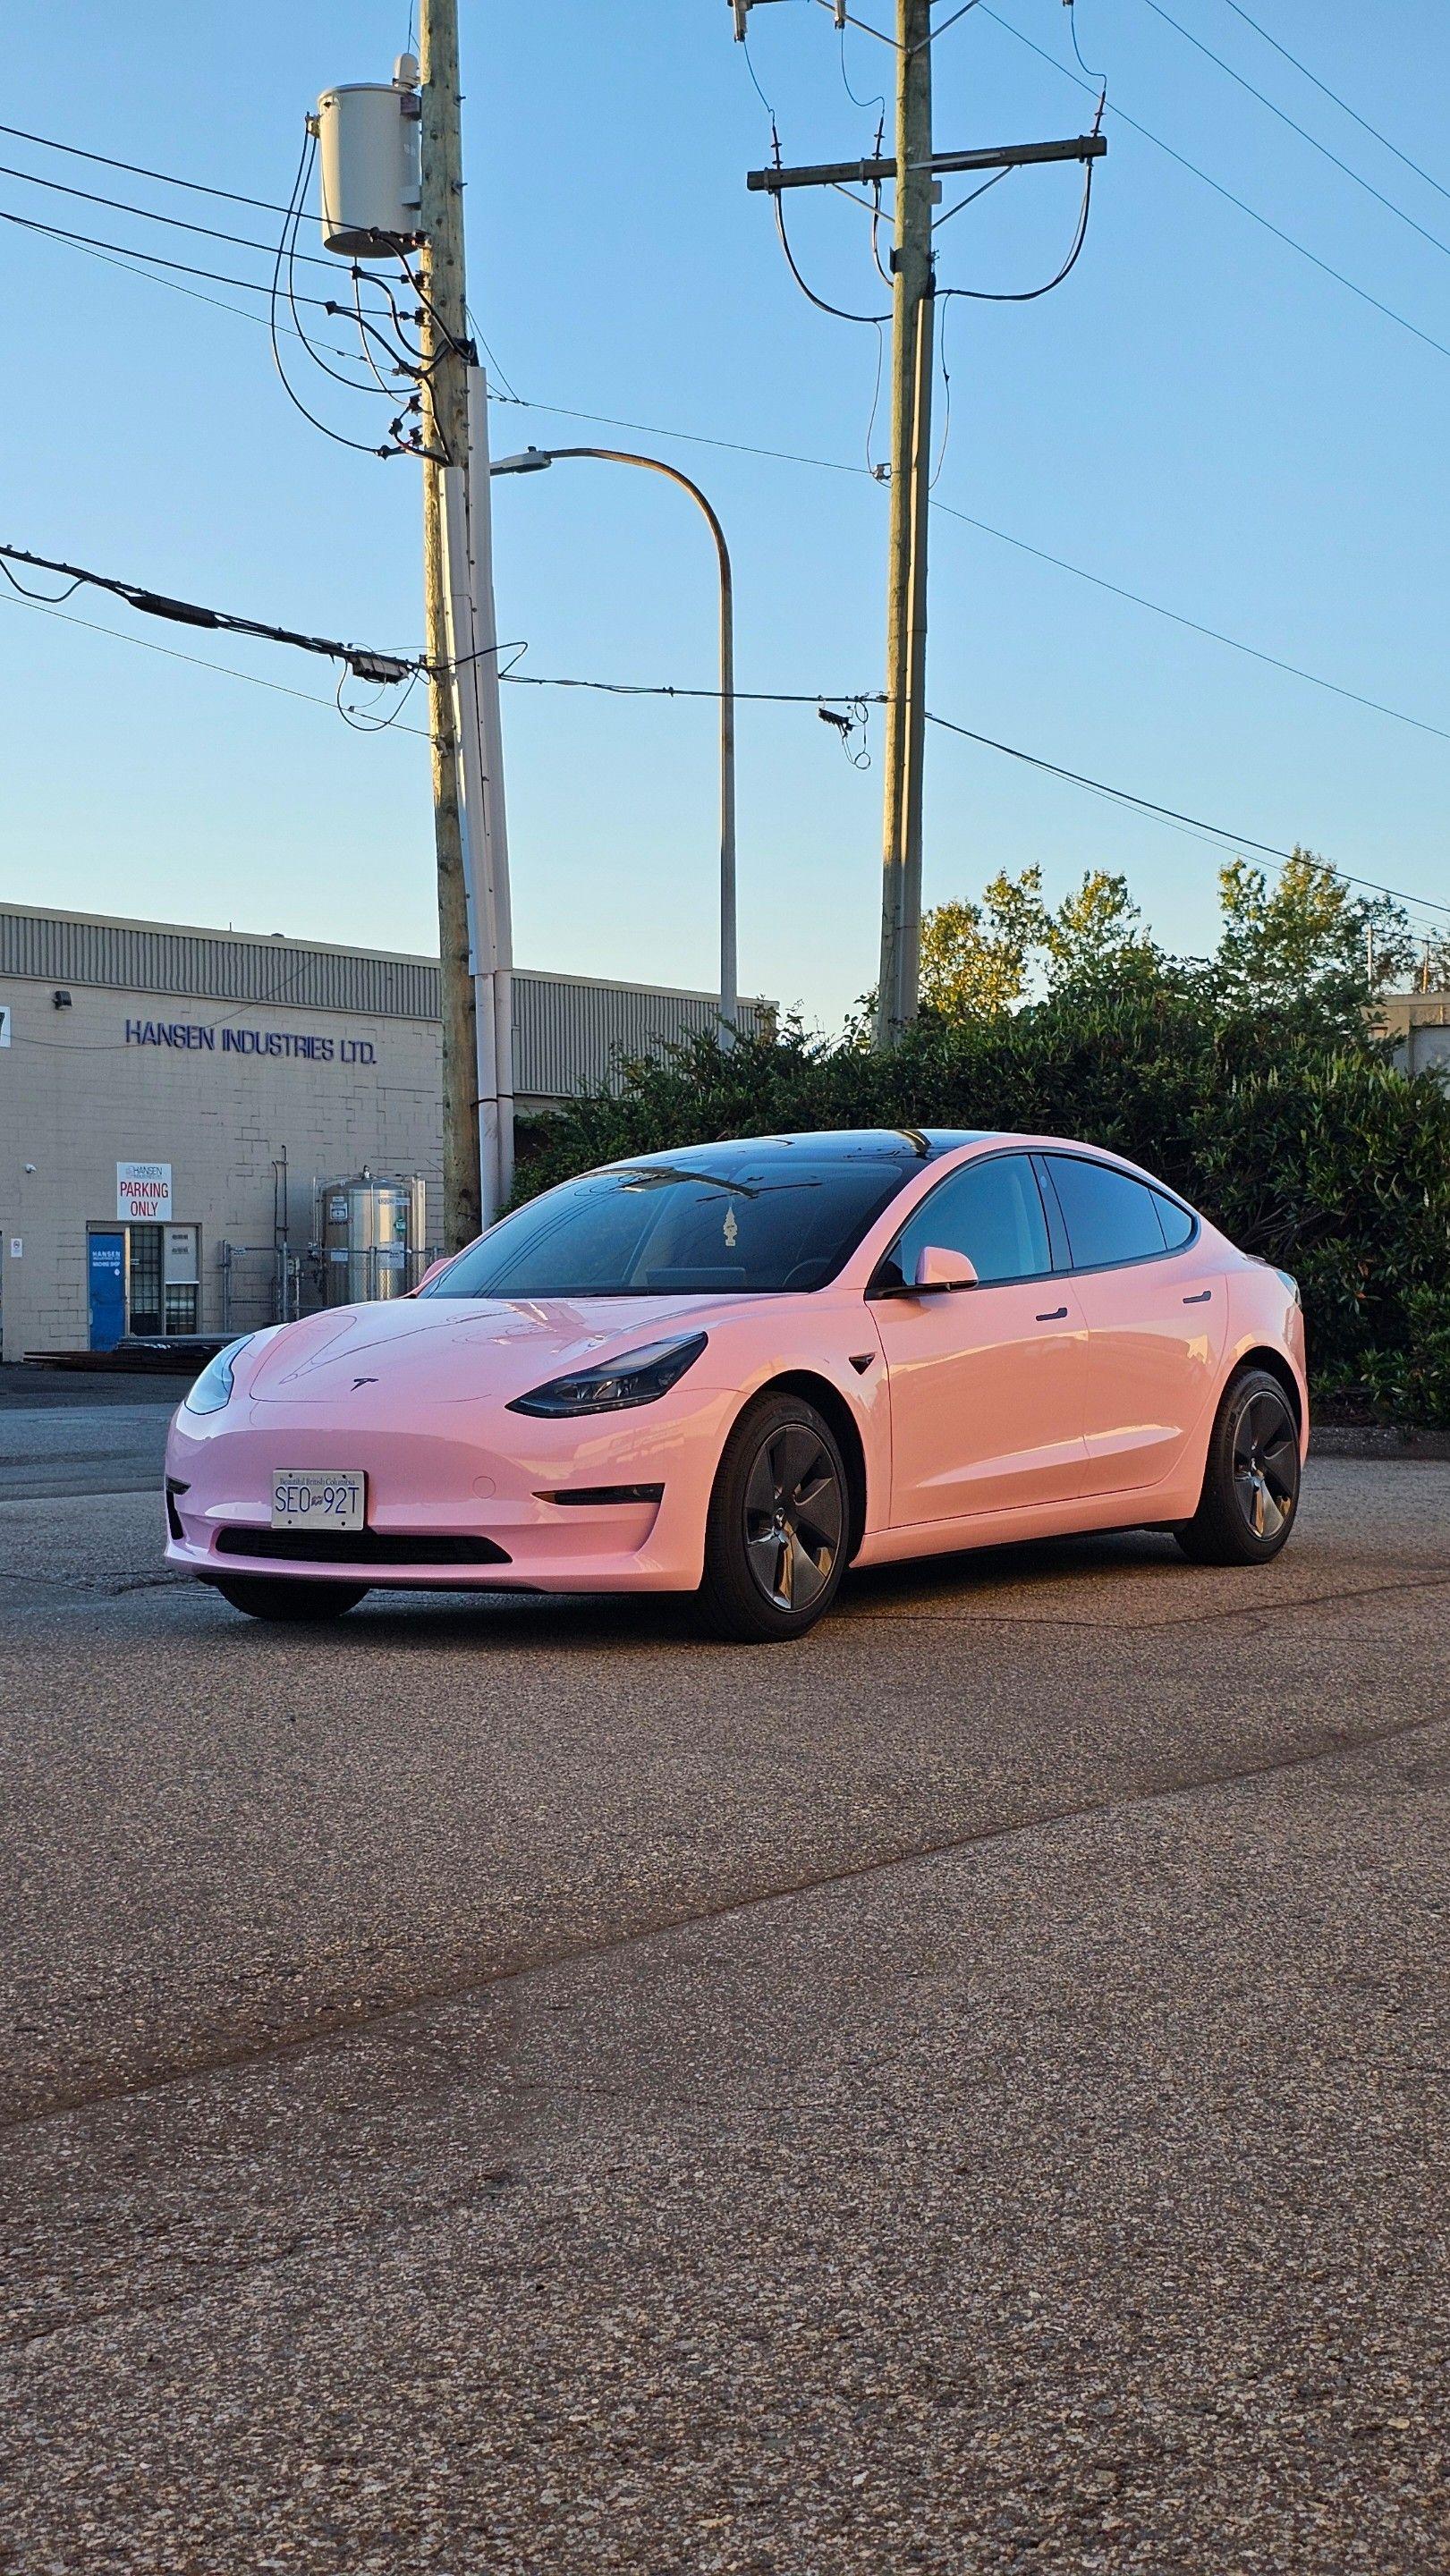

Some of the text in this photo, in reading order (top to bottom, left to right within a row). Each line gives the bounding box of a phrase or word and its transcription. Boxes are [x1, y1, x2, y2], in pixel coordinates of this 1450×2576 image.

[125, 1019, 377, 1064] HANSEN INDUSTRIES LTD.
[133, 1166, 163, 1175] HANSEN
[120, 1182, 169, 1198] PARKING
[131, 1200, 158, 1216] ONLY
[323, 1487, 360, 1514] 92T
